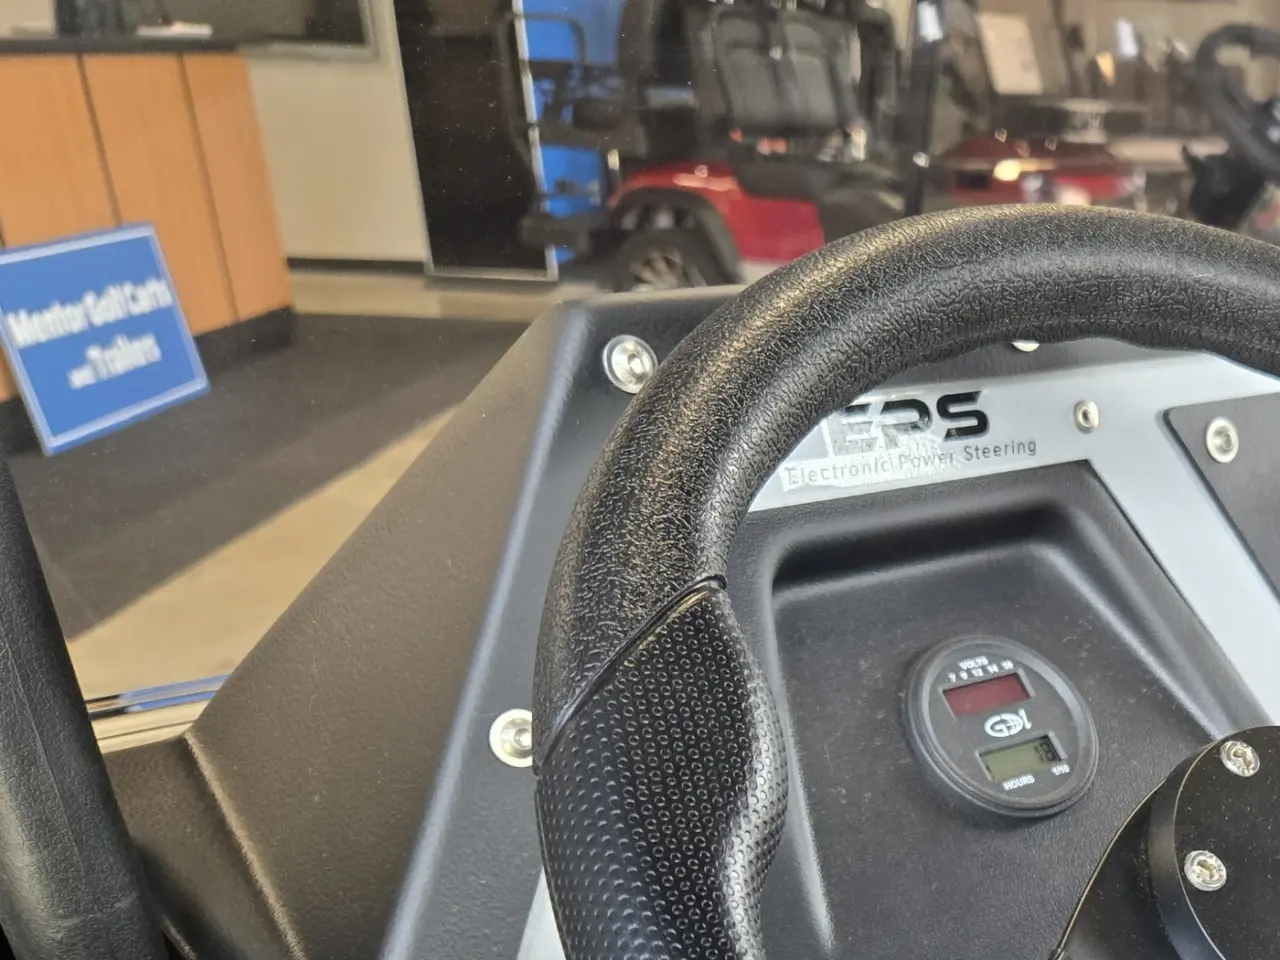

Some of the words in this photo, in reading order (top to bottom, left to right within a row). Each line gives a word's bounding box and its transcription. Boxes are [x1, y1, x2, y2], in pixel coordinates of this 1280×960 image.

[787, 454, 890, 486] Electronic
[898, 450, 956, 470] Power
[963, 438, 1037, 461] Steering
[1002, 774, 1035, 791] HOURS
